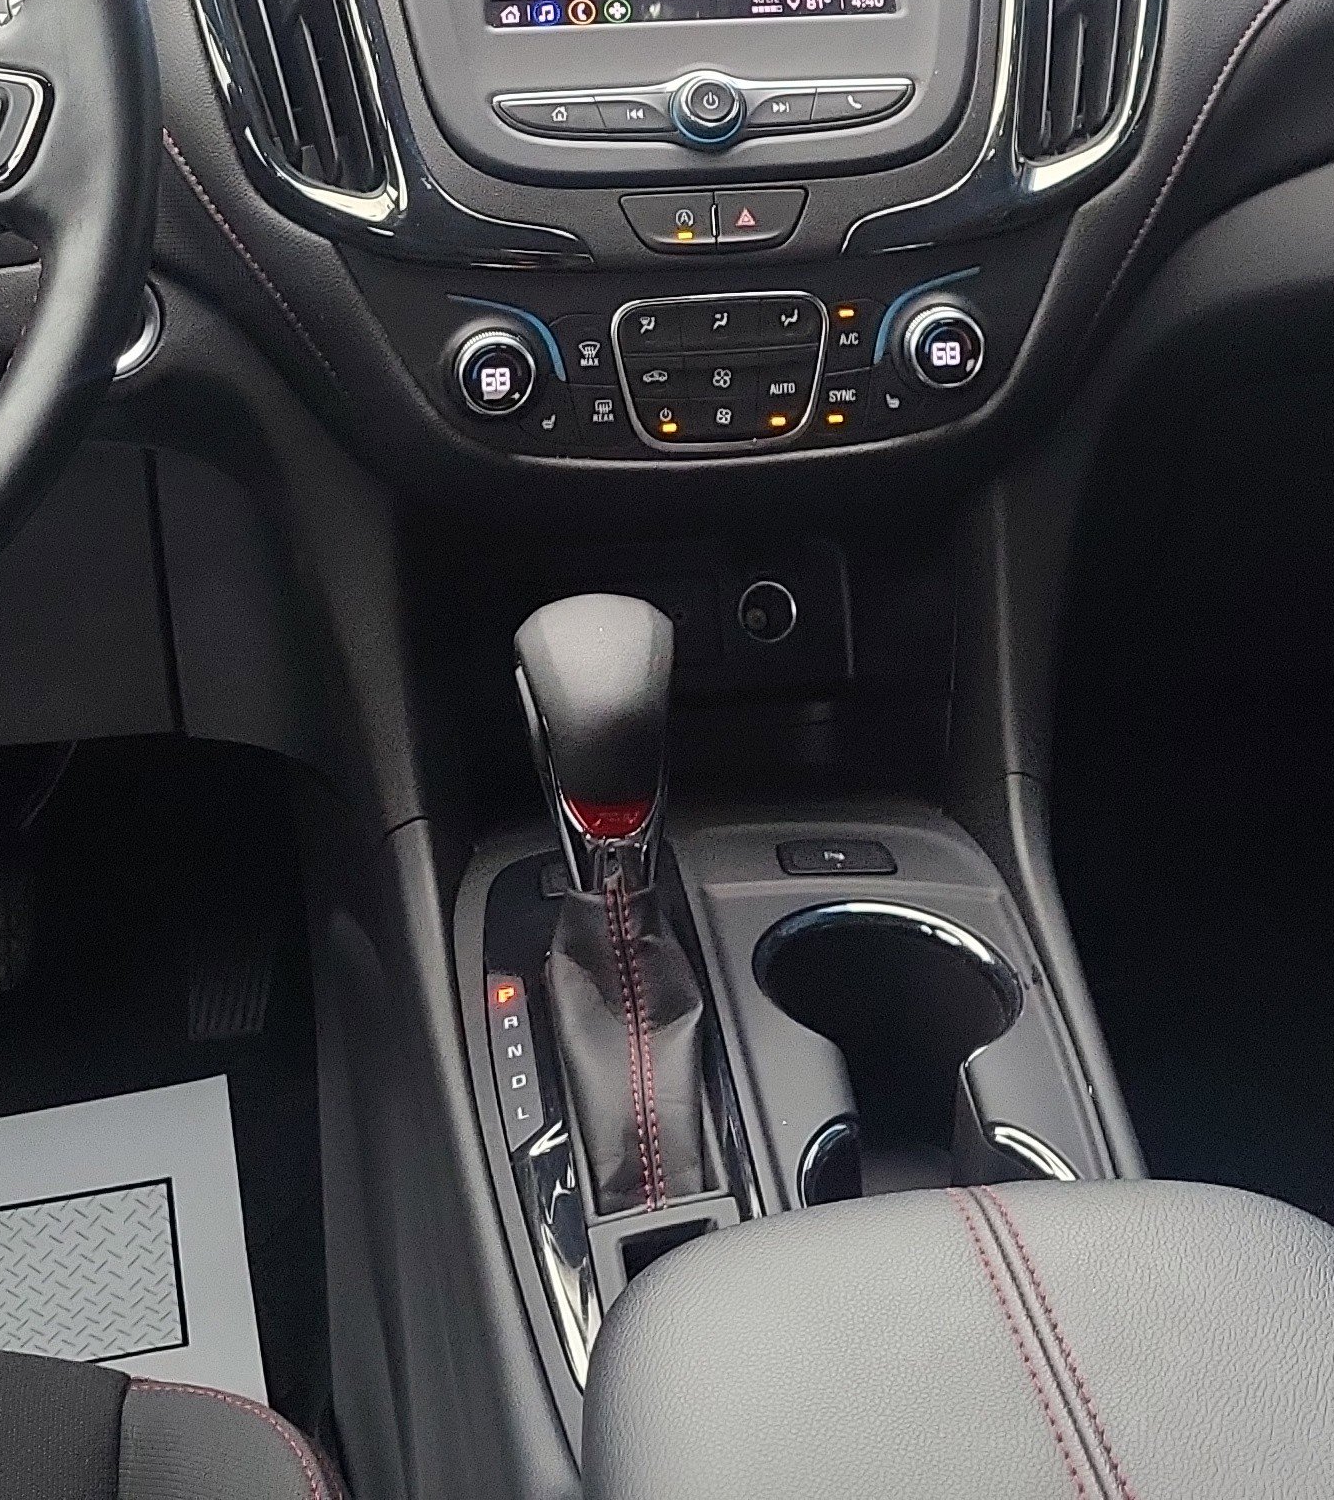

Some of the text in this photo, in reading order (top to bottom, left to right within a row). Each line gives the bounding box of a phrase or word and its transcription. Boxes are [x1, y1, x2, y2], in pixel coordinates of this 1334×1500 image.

[839, 333, 859, 346] A/C
[932, 342, 961, 367] 68
[580, 358, 600, 367] MAX
[481, 367, 511, 392] 68
[770, 382, 796, 395] AUTO
[828, 389, 856, 403] SYNC
[593, 413, 615, 422] REAR
[497, 987, 514, 1003] P
[504, 1015, 519, 1030] R
[507, 1043, 522, 1059] N
[512, 1074, 527, 1089] D
[517, 1106, 530, 1120] L
